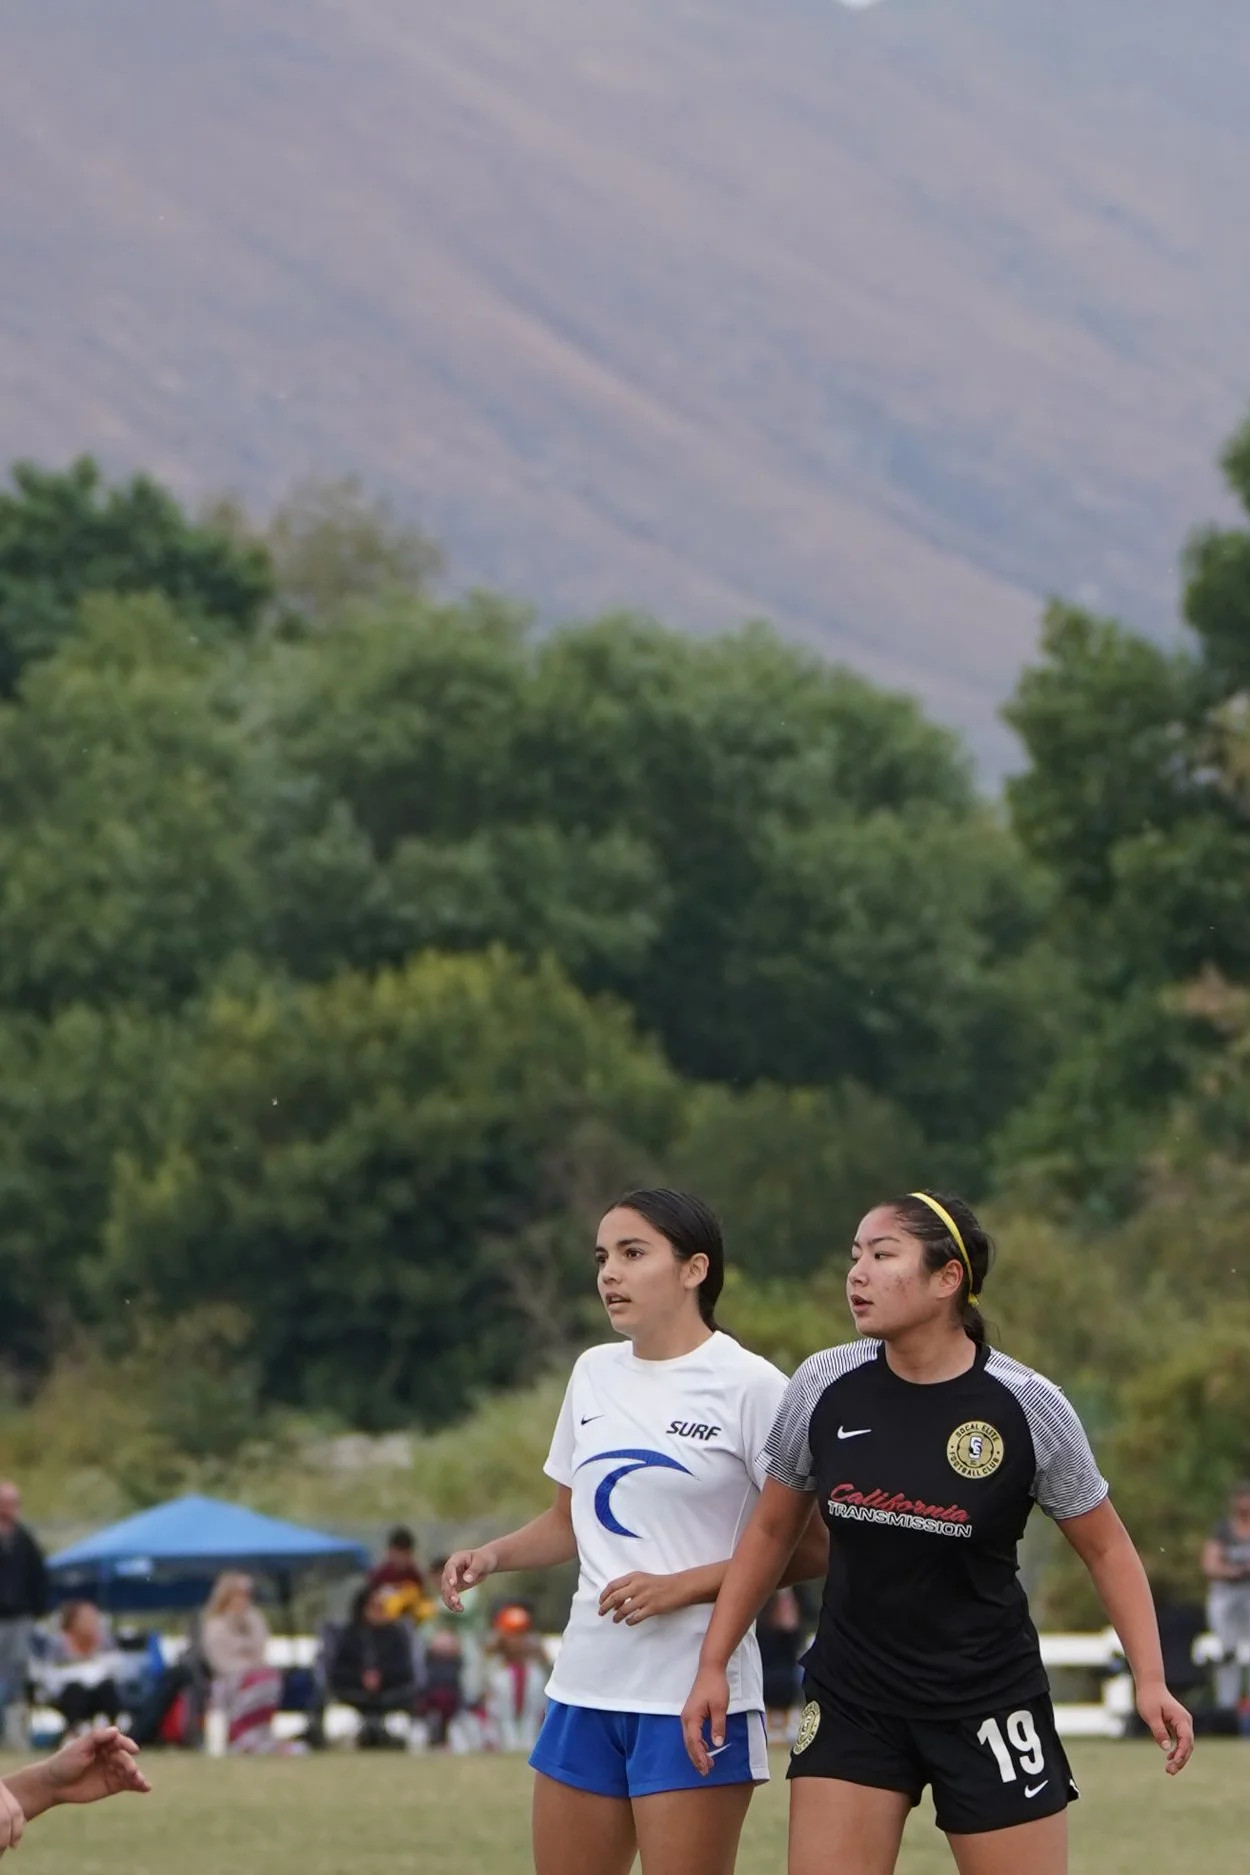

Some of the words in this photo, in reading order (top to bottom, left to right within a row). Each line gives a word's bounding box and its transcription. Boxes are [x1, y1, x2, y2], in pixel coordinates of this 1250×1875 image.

[666, 1420, 722, 1441] SURF
[955, 1423, 979, 1438] SOCAL
[981, 1424, 1000, 1441] ELITE
[949, 1451, 981, 1476] FOOTBALL
[982, 1457, 1000, 1474] CLUB
[830, 1482, 970, 1523] California
[828, 1500, 972, 1538] TRANSMISSION
[976, 1710, 1045, 1783] 19
